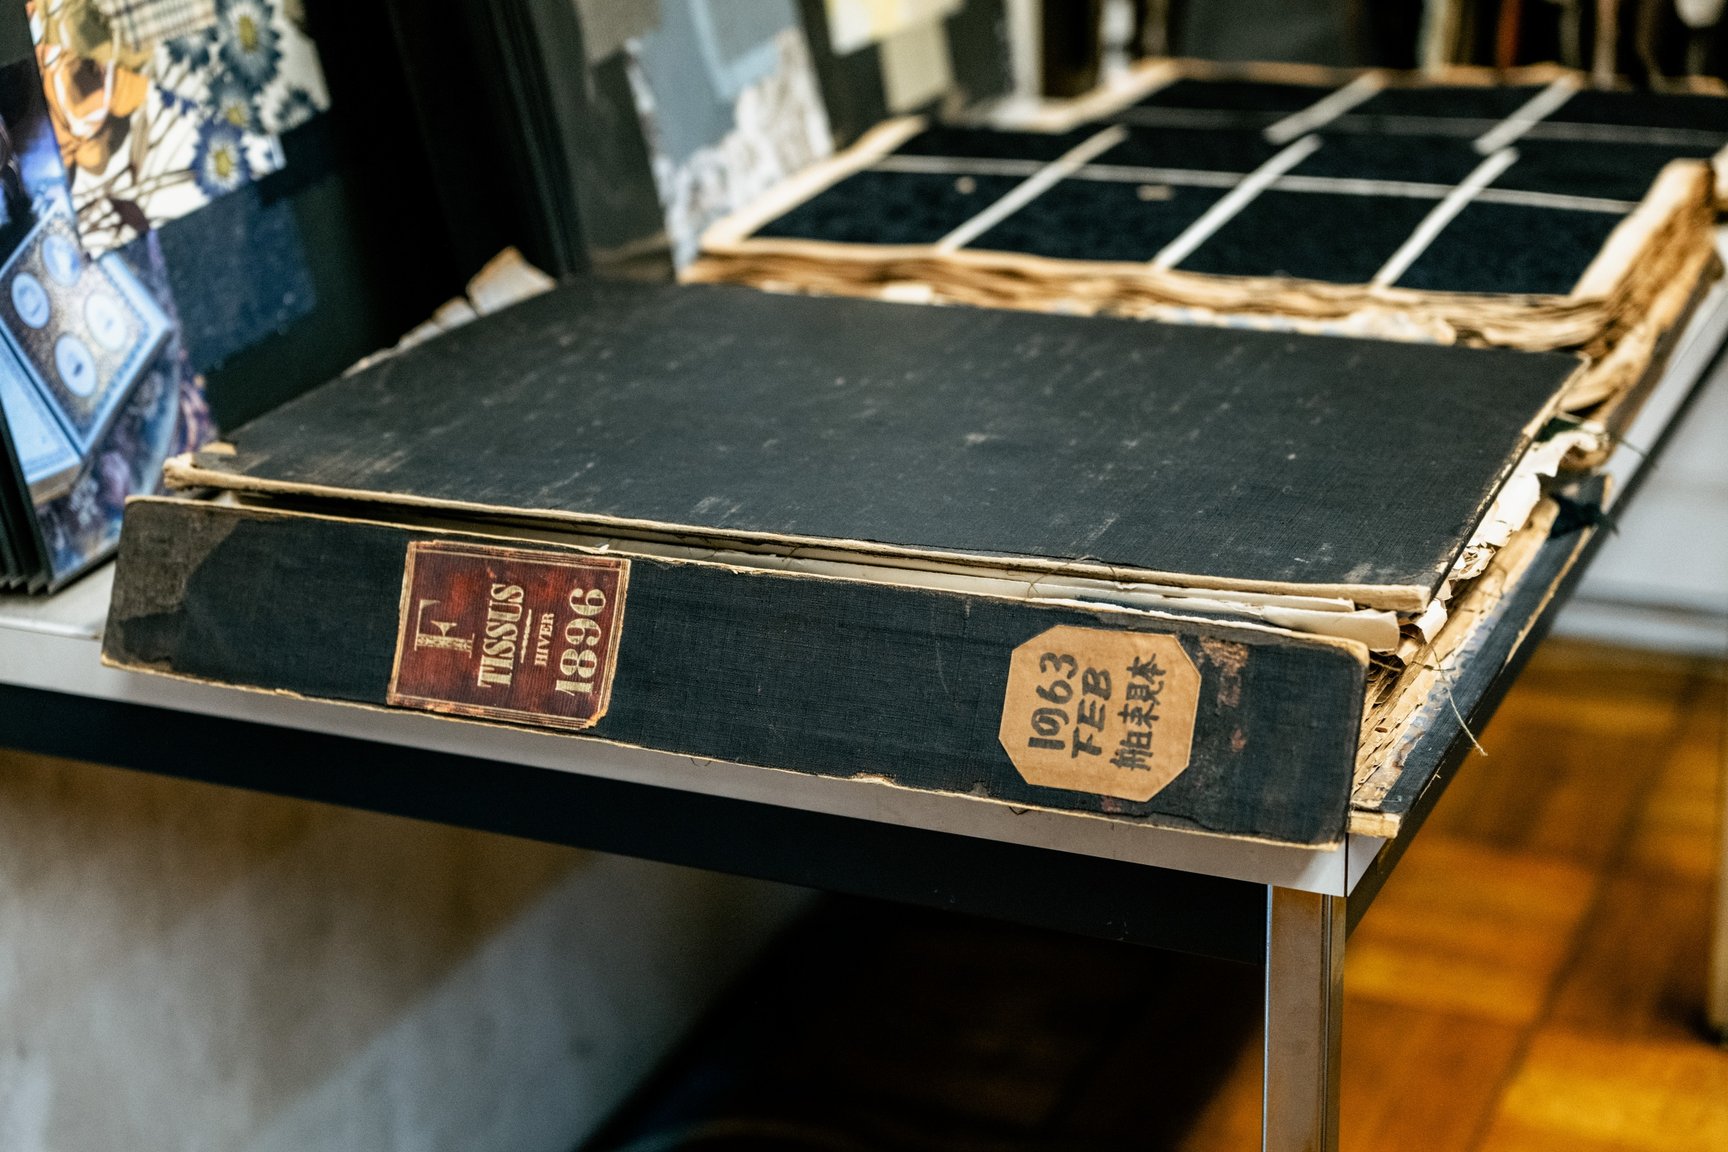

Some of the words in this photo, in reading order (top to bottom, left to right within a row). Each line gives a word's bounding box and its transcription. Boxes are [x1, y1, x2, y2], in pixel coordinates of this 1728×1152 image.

[415, 600, 475, 659] F
[477, 583, 524, 688] TISSUS
[534, 612, 555, 667] HIVER
[555, 588, 606, 697] 1896
[1028, 652, 1079, 750] 1963
[1071, 667, 1112, 759] FEB
